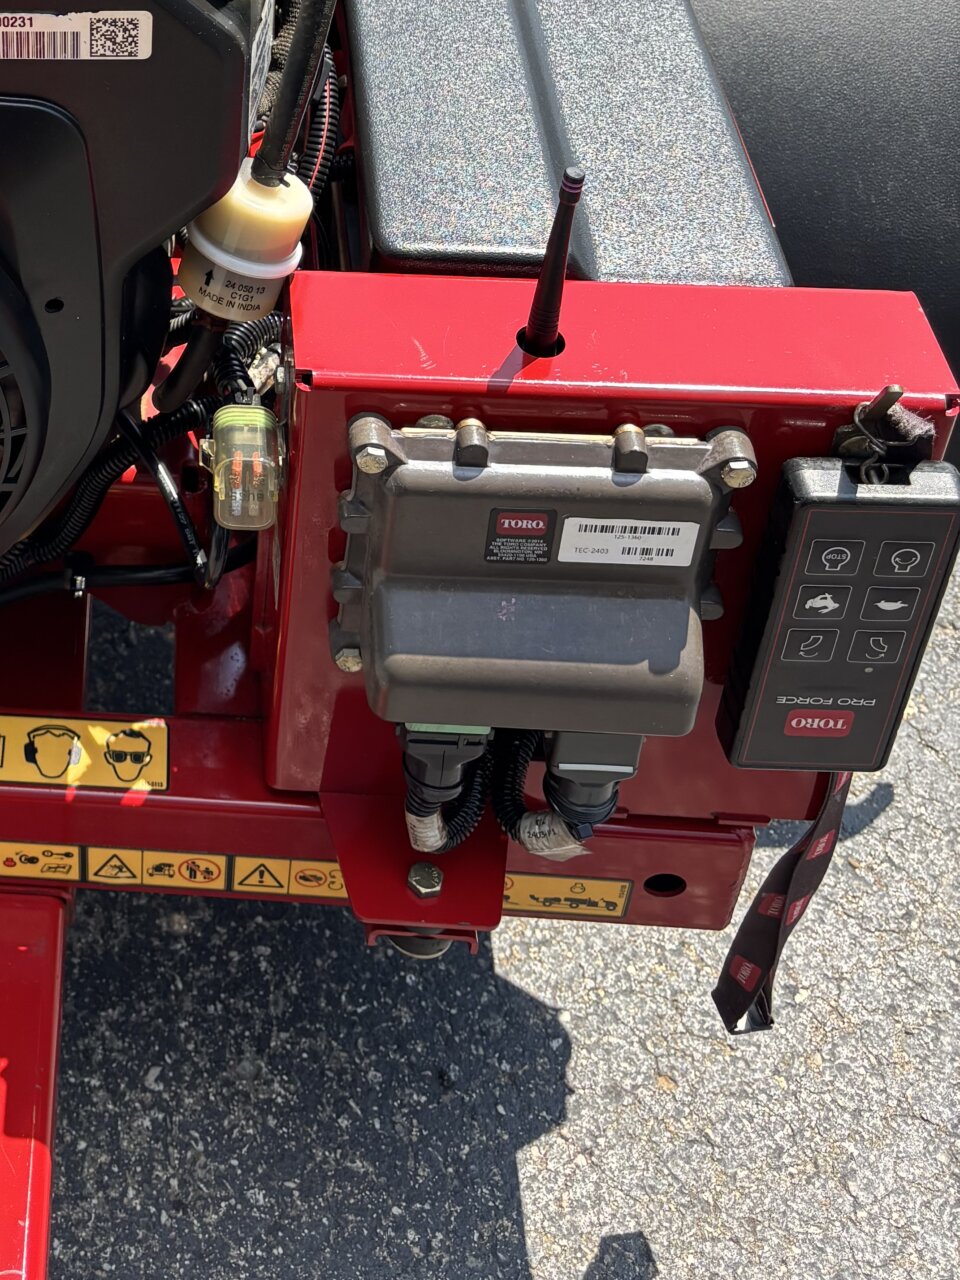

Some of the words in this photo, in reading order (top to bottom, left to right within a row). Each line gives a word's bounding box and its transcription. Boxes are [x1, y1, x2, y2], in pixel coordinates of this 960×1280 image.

[225, 280, 236, 289] 24
[238, 283, 254, 294] 050
[256, 286, 266, 294] 13
[198, 286, 225, 305] MADE
[225, 300, 236, 309] IN
[237, 303, 261, 312] INDIA
[501, 519, 545, 529] TORO
[574, 547, 609, 555] TEC-2403
[775, 695, 833, 706] FORCE
[837, 697, 877, 707] PRO
[790, 717, 848, 731] TORO
[737, 962, 752, 985] TORO
